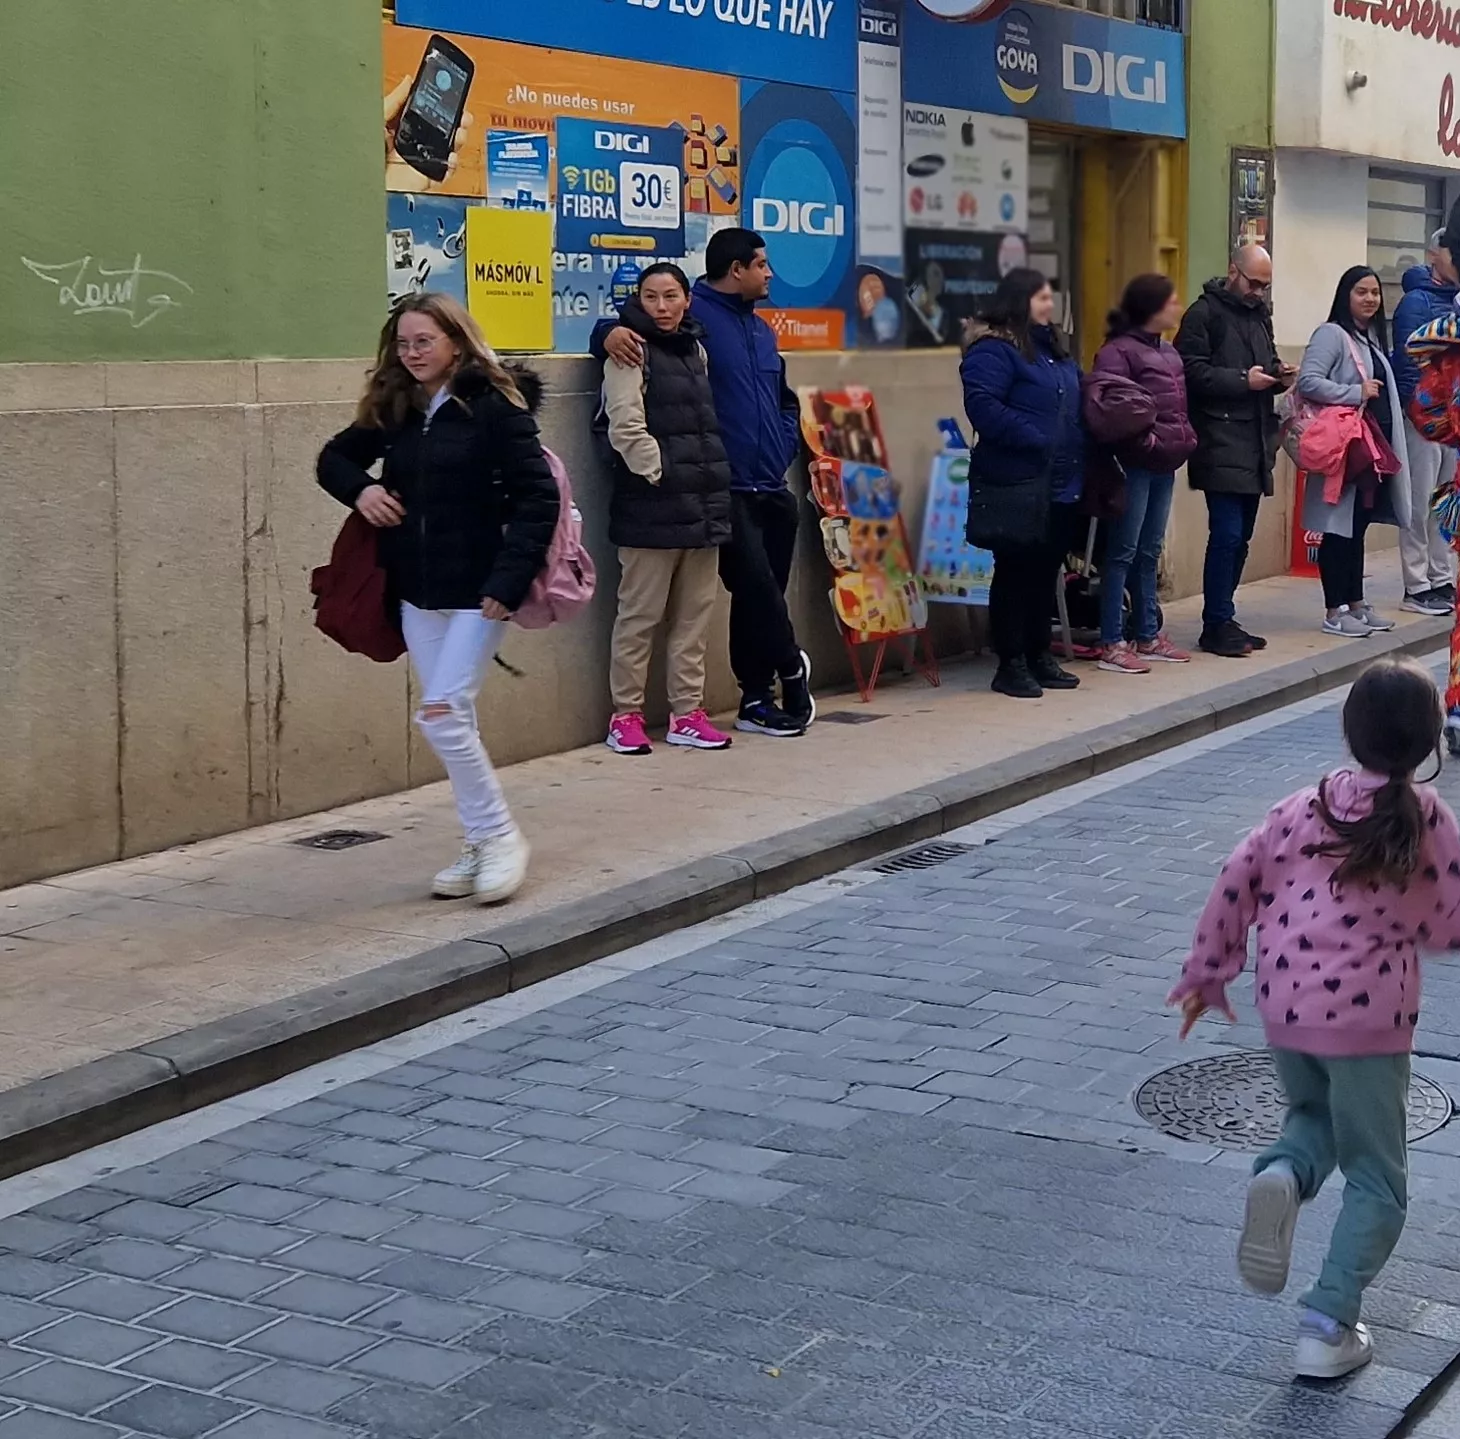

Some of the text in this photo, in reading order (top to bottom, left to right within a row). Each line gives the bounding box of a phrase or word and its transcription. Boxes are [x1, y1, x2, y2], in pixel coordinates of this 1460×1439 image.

[714, 0, 771, 29] QUE
[779, 0, 834, 39] HAY
[860, 17, 897, 36] DIGI
[997, 44, 1038, 75] GOYA
[1063, 43, 1167, 104] DIGI
[506, 83, 636, 116] ¿No puedes usar
[905, 108, 947, 127] NOKIA
[594, 130, 650, 154] DIGI
[582, 168, 616, 194] 1Gb
[562, 194, 618, 220] FIBRA
[752, 198, 845, 236] DIGI
[552, 251, 593, 273] era
